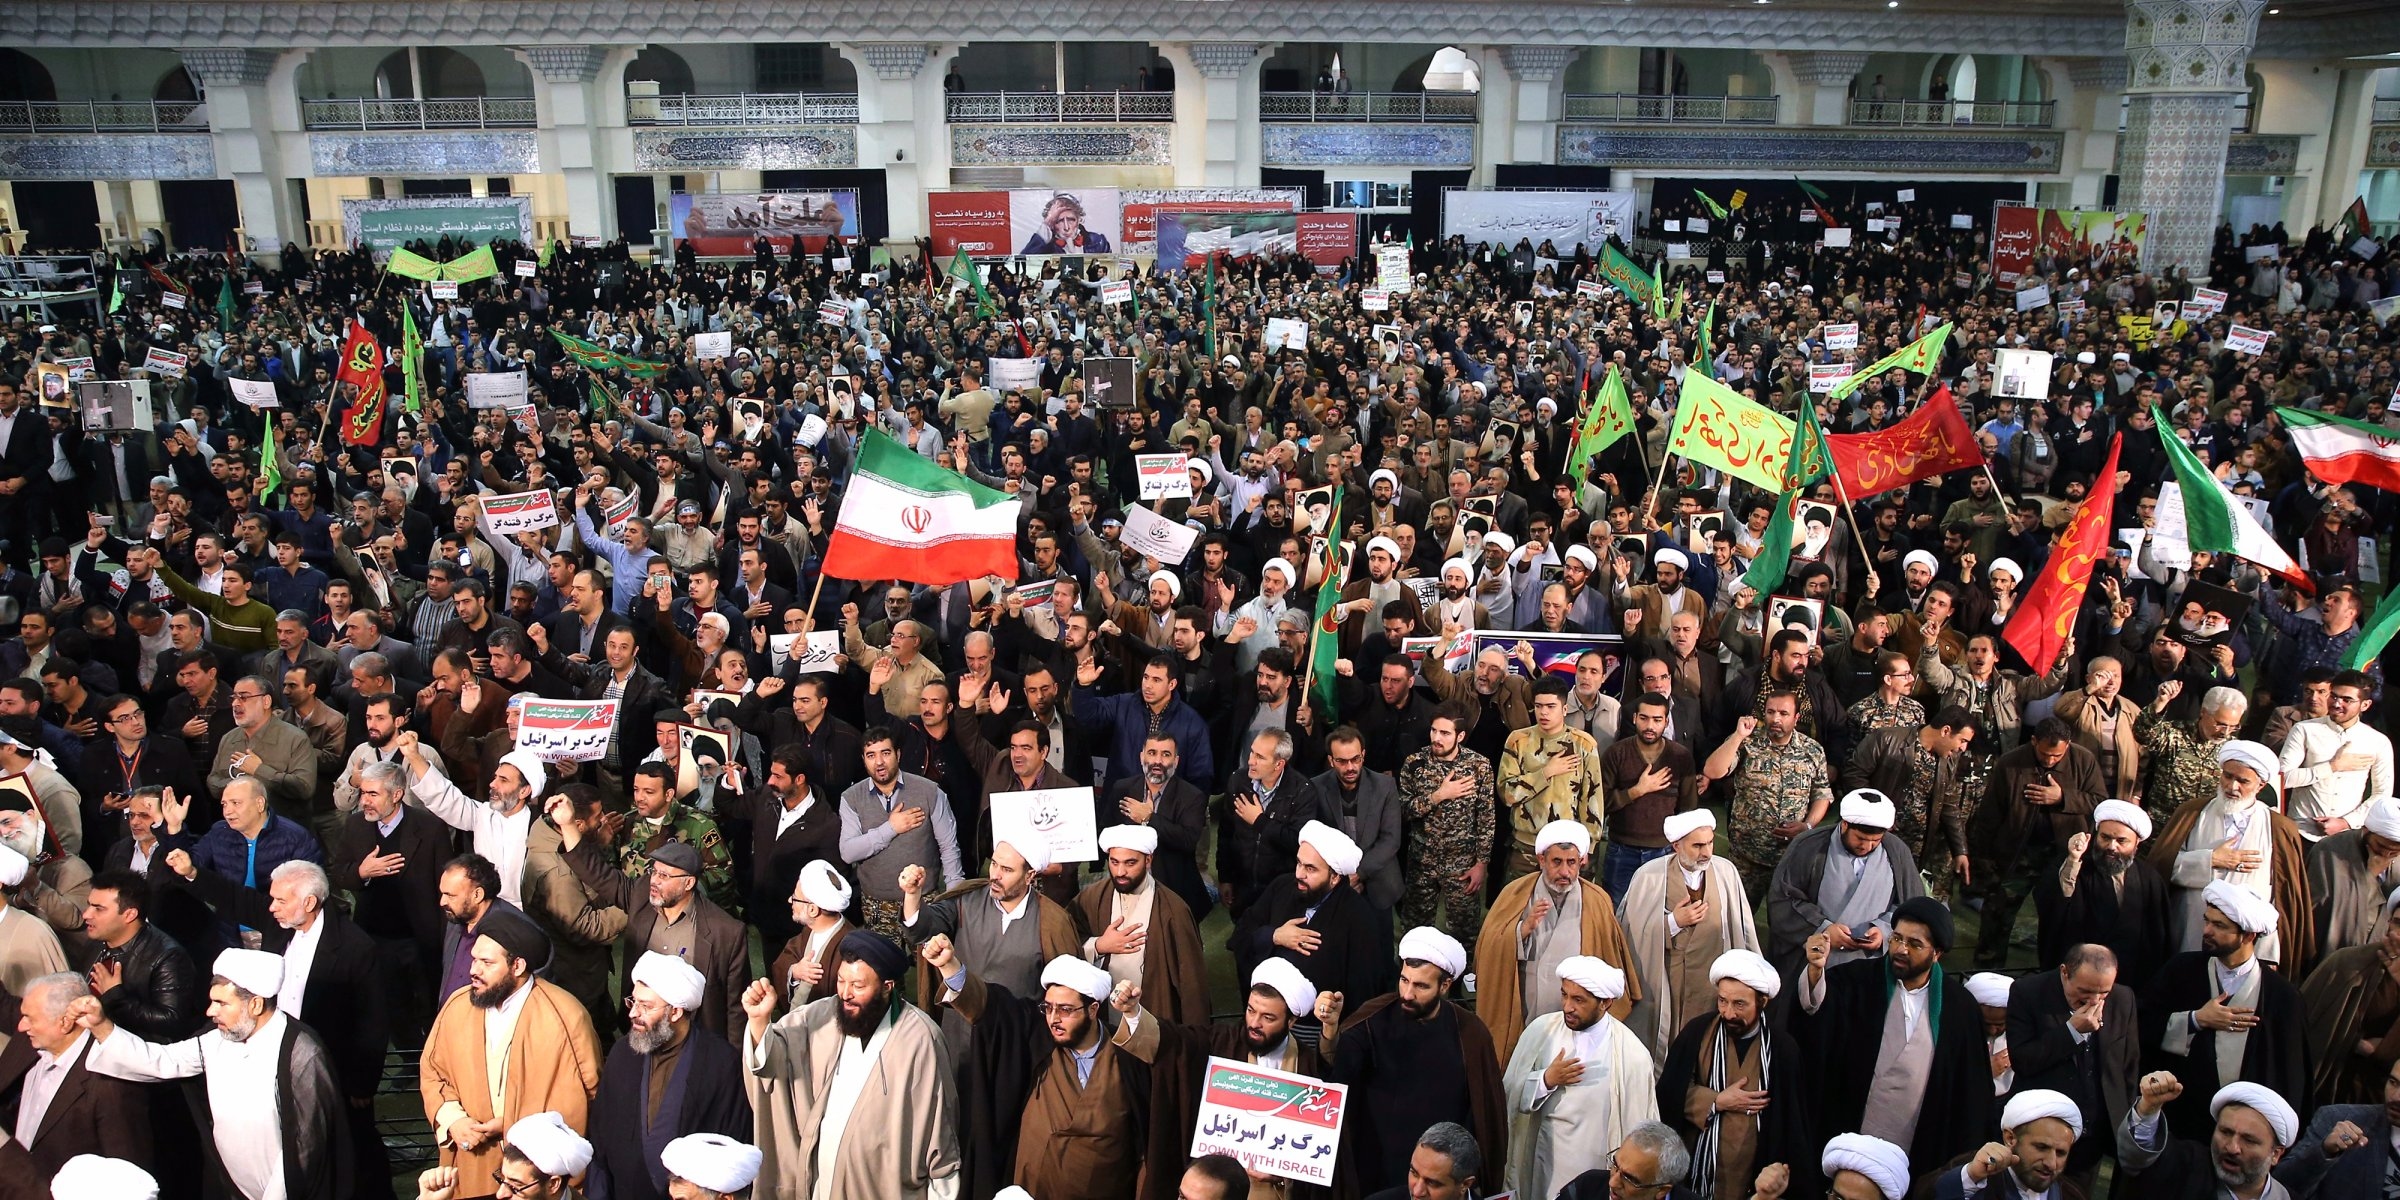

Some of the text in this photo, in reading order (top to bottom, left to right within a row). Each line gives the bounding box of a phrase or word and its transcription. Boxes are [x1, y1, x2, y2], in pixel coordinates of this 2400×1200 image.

[726, 195, 775, 229] آمد
[935, 209, 1005, 219] به روز سیاه نشست
[1127, 215, 1156, 225] مردم بود
[1303, 221, 1349, 230] حماسه وحدت
[364, 223, 382, 232] است
[384, 222, 403, 234] نظام
[405, 223, 413, 234] به
[415, 223, 434, 234] مردم
[435, 221, 469, 234] دلبستگی
[469, 221, 493, 233] مظهر
[1144, 479, 1189, 493] مرگ بر فتنه گر
[493, 513, 554, 530] مرگ بر فتنه گر
[521, 731, 607, 751] مرگ بر اسرائیل
[551, 752, 574, 760] WITH
[575, 750, 604, 760] ISRAEL
[1228, 1073, 1279, 1090] تجلی دست قدرت الهی
[1260, 1089, 1272, 1097] فتنه
[1272, 1092, 1288, 1100] شکست
[1302, 1099, 1340, 1122] حماسه
[1203, 1113, 1332, 1159] مرگ بر اسرائیل
[1198, 1142, 1327, 1179] DOWN WITH ISRAEL
